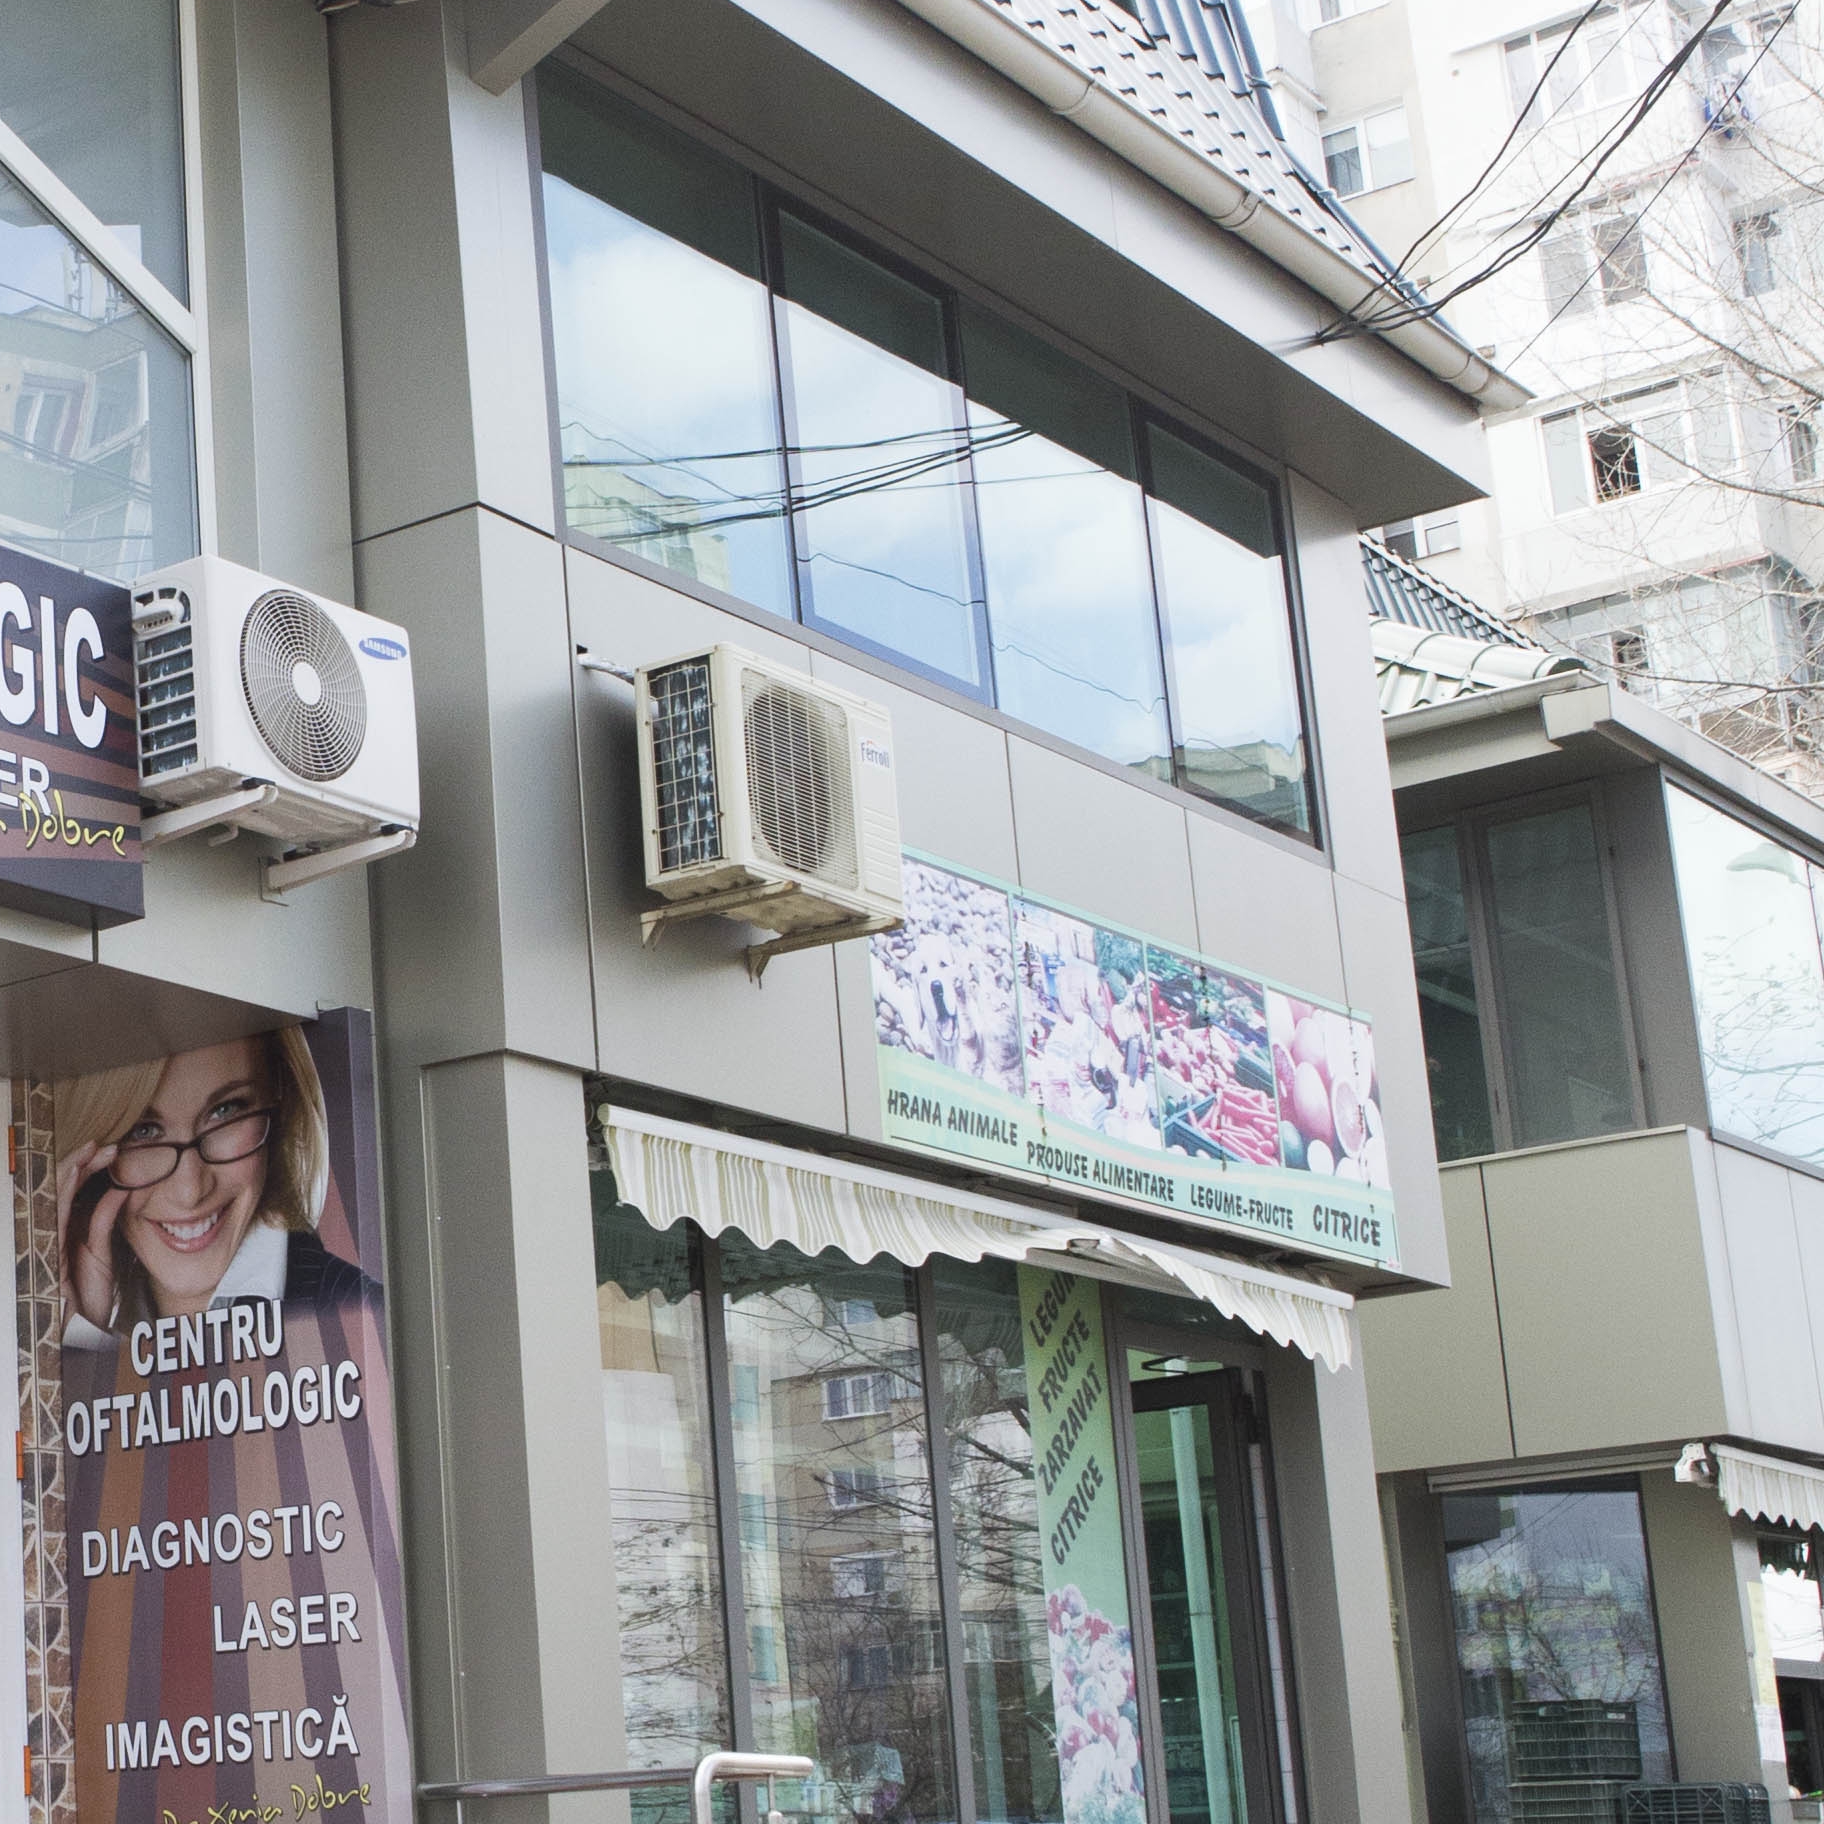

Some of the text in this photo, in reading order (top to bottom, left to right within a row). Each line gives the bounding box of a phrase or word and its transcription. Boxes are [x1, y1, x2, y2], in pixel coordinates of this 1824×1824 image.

[20, 787, 127, 857] Dobre
[887, 1088, 1382, 1247] HRANA ANIMALE PRODUSE ALIMENTARE LEGUME-FRUCTE CITRICE
[131, 1299, 285, 1377] CENTRU
[1037, 1308, 1091, 1414] FRUCTE
[66, 1360, 362, 1457] OFTALMOLOGIC
[1037, 1362, 1103, 1497] ZARZAVAT
[82, 1500, 345, 1578] DIAGNOSTIC
[1050, 1454, 1104, 1566] CITRICE
[213, 1591, 362, 1653] LASER
[105, 1693, 360, 1771] IMAGISTICĂ
[290, 1774, 372, 1822] Dobre
